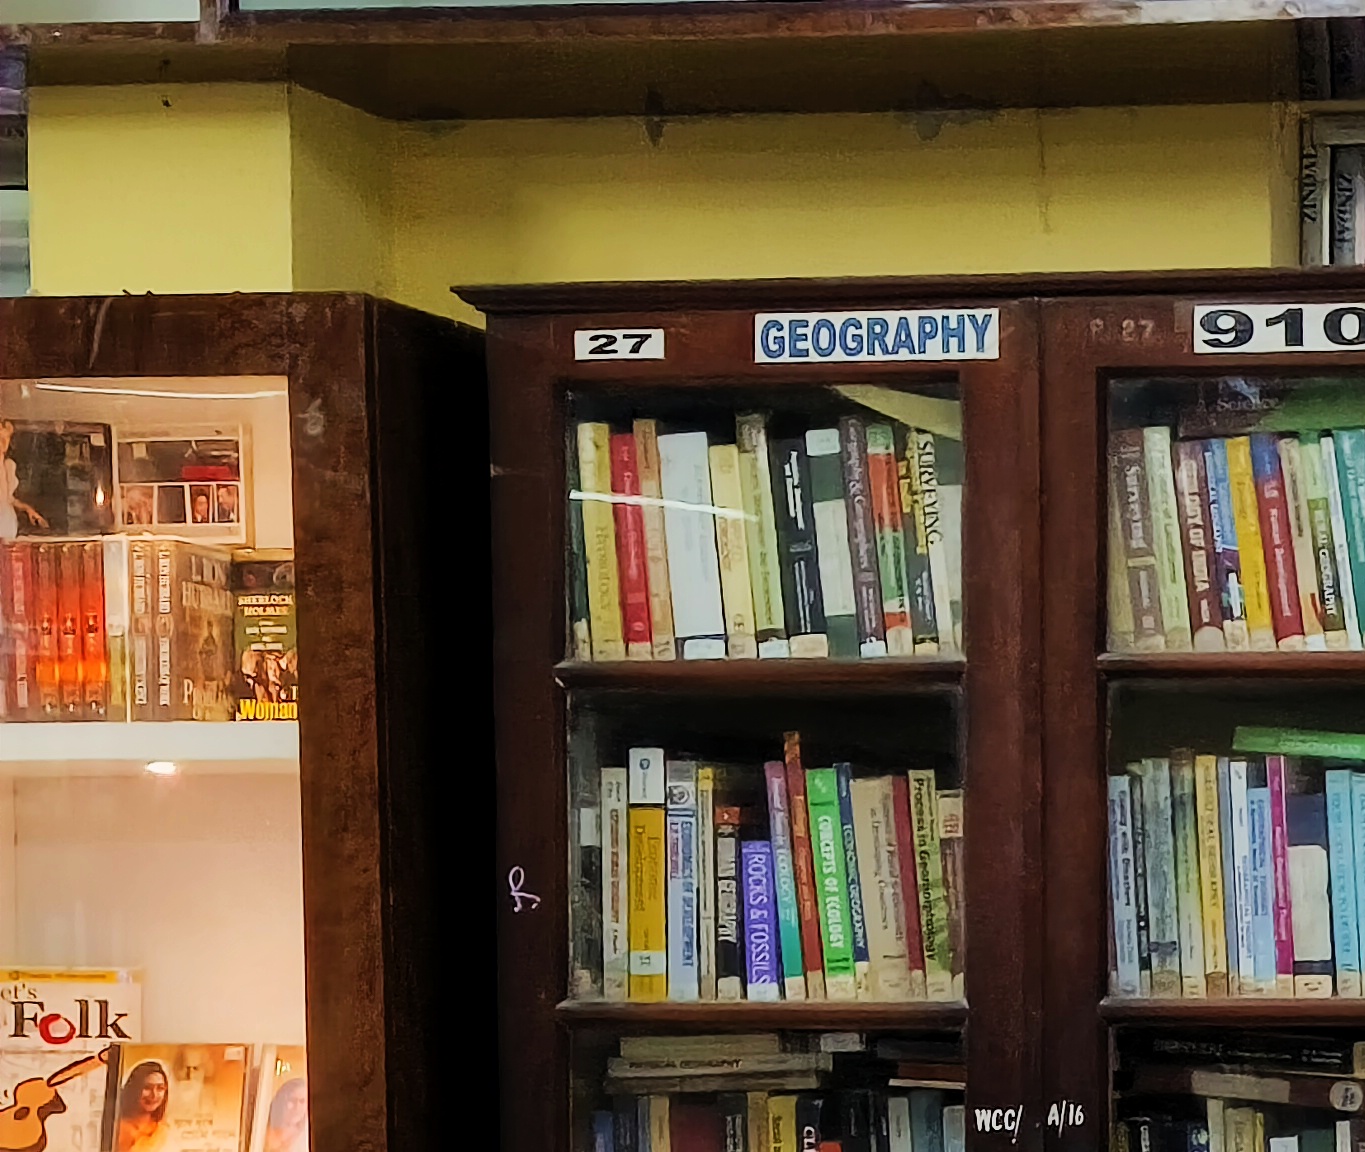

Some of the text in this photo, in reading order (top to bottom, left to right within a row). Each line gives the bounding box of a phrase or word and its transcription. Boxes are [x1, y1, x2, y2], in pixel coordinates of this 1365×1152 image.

[588, 333, 653, 355] 27
[759, 313, 993, 359] GEOGRAPHY
[240, 698, 297, 721] Woman
[818, 815, 845, 949] CONCEPTS OF ECOLOGY
[747, 854, 772, 984] ROCKS FOSSILS
[848, 884, 866, 949] GEOGRAPHY
[9, 999, 131, 1045] Folk
[974, 1105, 1024, 1136] WCC/
[1047, 1099, 1084, 1137] A/16
